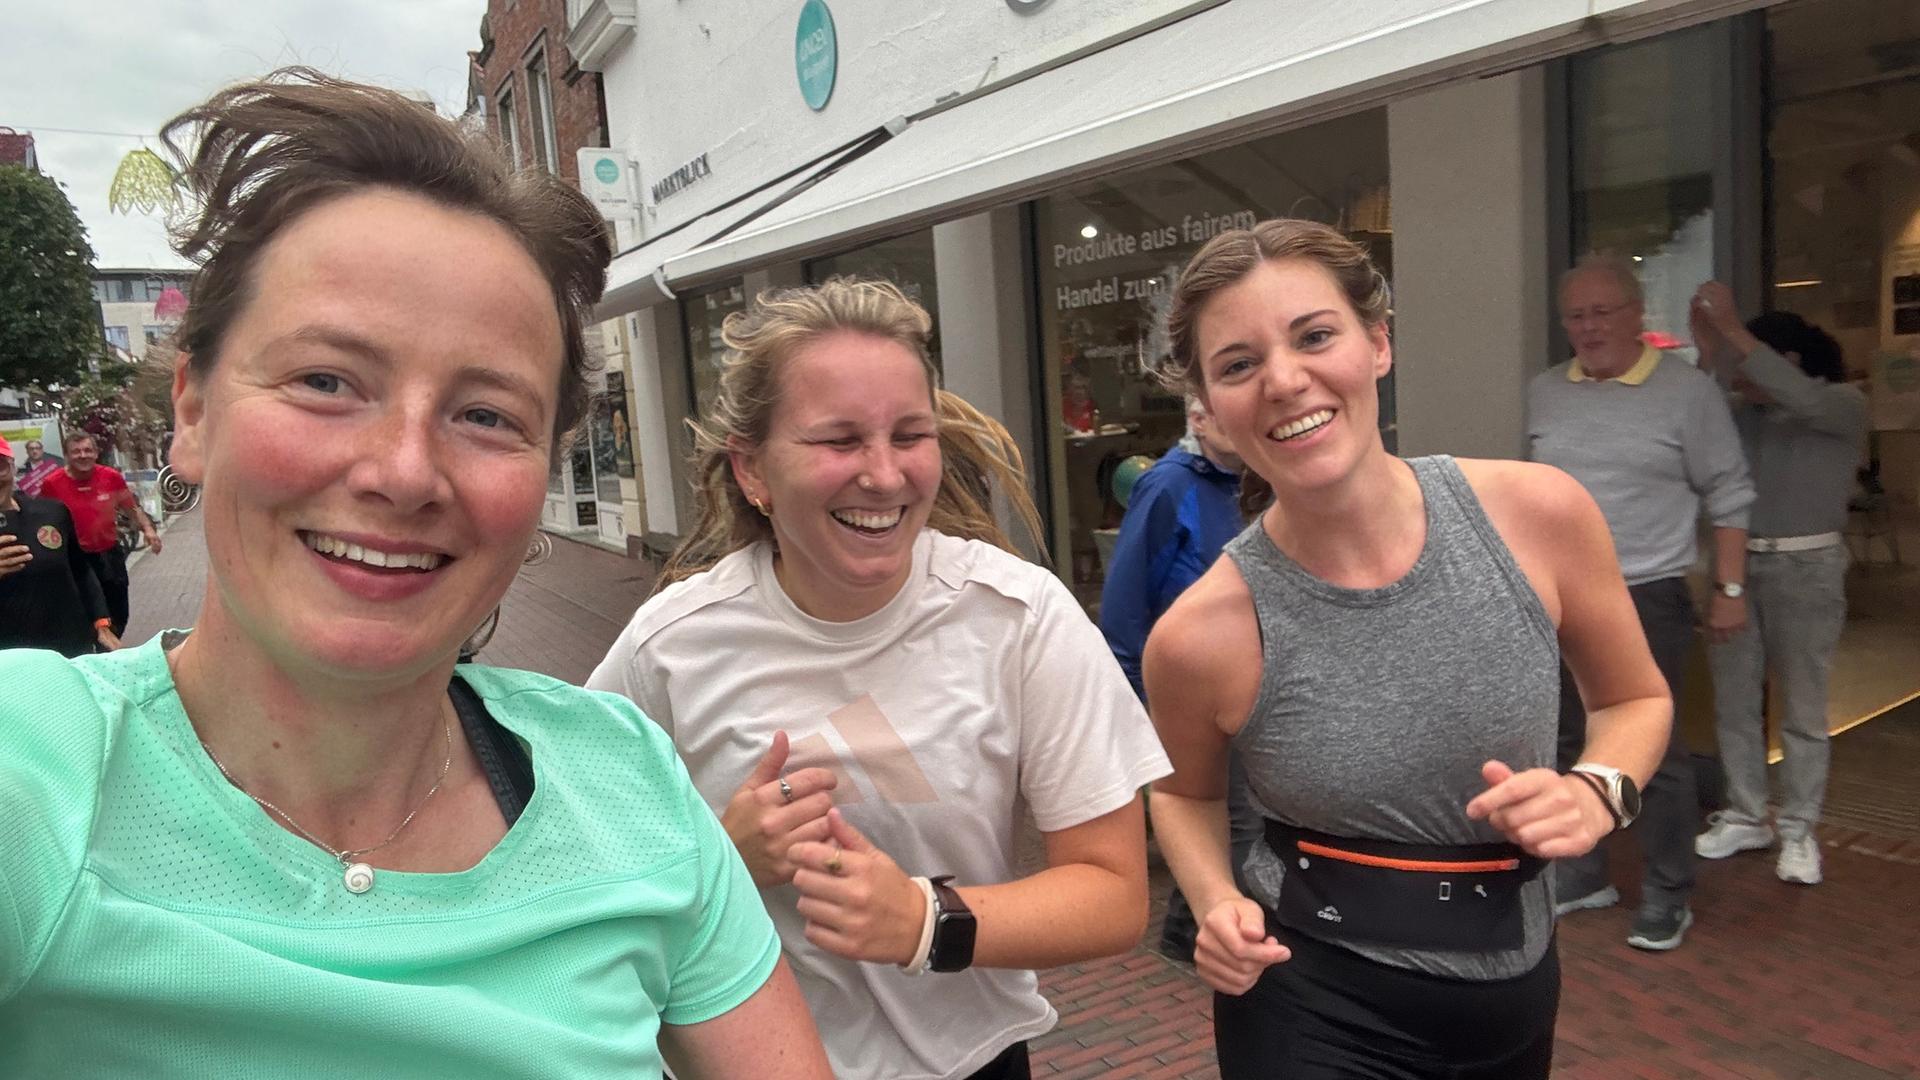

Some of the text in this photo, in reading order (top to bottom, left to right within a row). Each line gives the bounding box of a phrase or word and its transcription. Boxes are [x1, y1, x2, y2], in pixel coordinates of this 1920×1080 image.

[652, 152, 711, 204] MARKTBLICK
[1054, 210, 1255, 267] Produkte aus fairem
[1056, 277, 1119, 309] Handel
